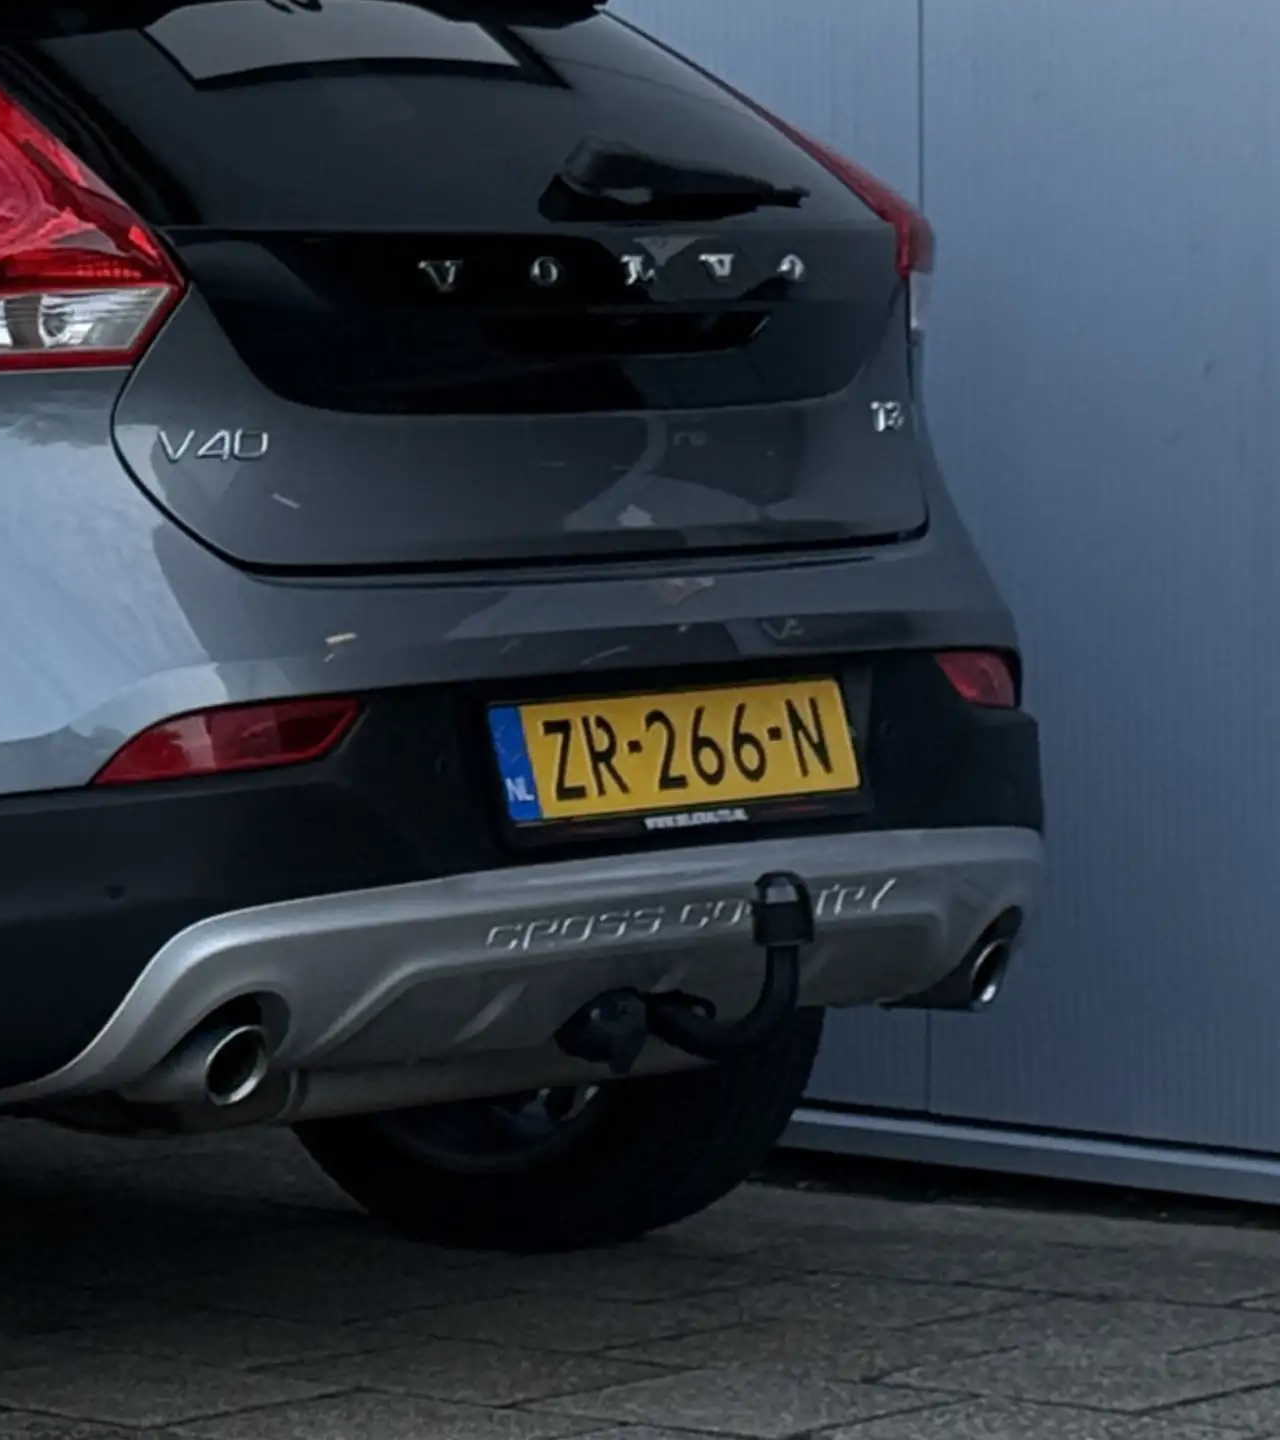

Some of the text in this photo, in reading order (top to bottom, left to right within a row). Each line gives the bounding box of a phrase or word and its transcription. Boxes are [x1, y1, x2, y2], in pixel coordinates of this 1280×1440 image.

[417, 252, 806, 293] VOLVO
[159, 427, 269, 463] V40
[540, 696, 835, 802] ZR-266-N
[505, 776, 536, 802] NL
[486, 877, 898, 953] CROSS COTRY
